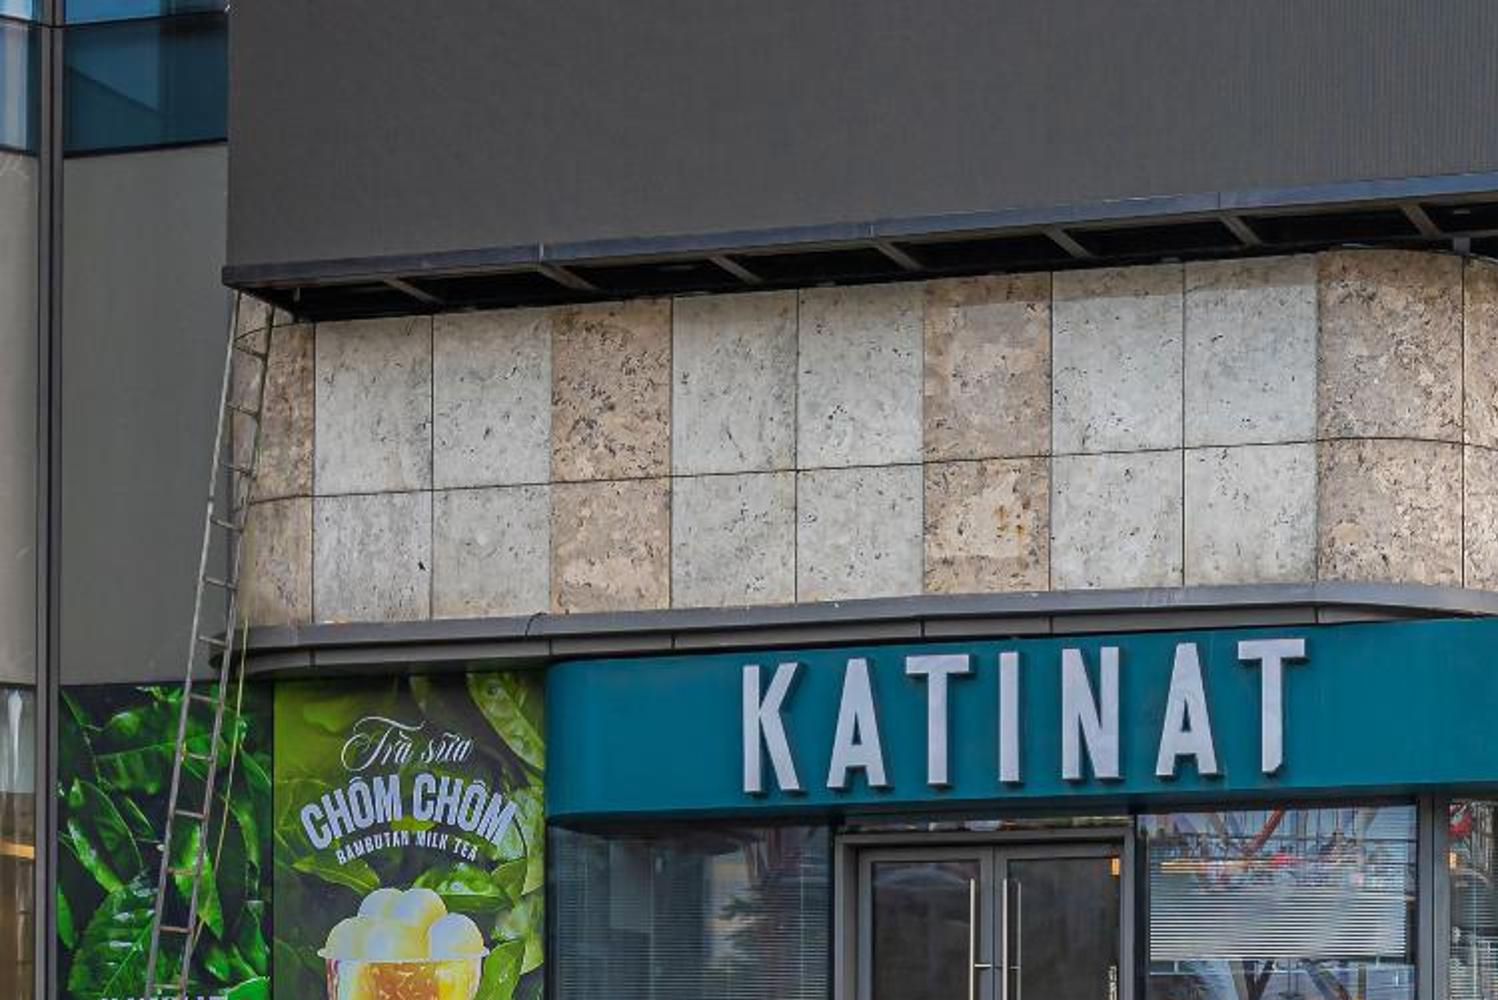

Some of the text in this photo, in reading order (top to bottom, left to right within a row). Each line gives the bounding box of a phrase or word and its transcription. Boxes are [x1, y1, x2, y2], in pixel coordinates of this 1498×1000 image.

[743, 638, 1306, 794] KATINAT
[301, 772, 519, 850] CHÔM CHÔM
